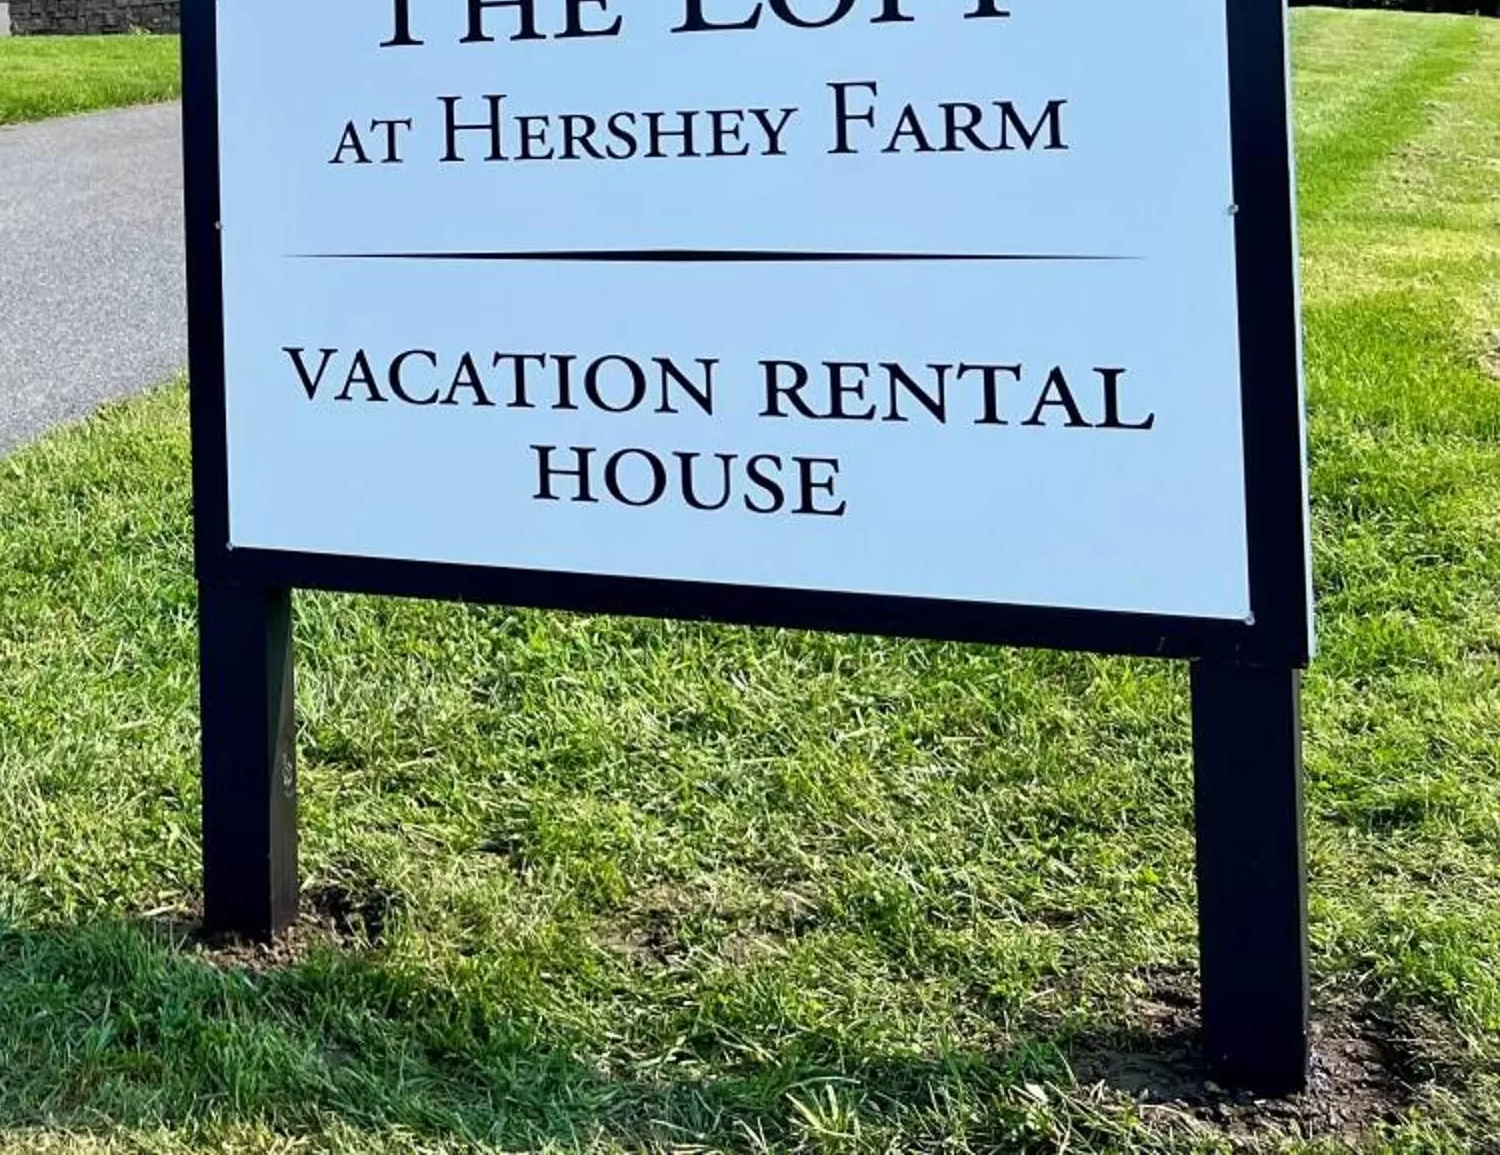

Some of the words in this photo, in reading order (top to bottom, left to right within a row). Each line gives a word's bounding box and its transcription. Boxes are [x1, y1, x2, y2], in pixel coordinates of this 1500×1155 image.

[282, 347, 719, 416] VACATION
[758, 360, 1155, 430] RENTAL
[529, 444, 847, 517] HOUSE
